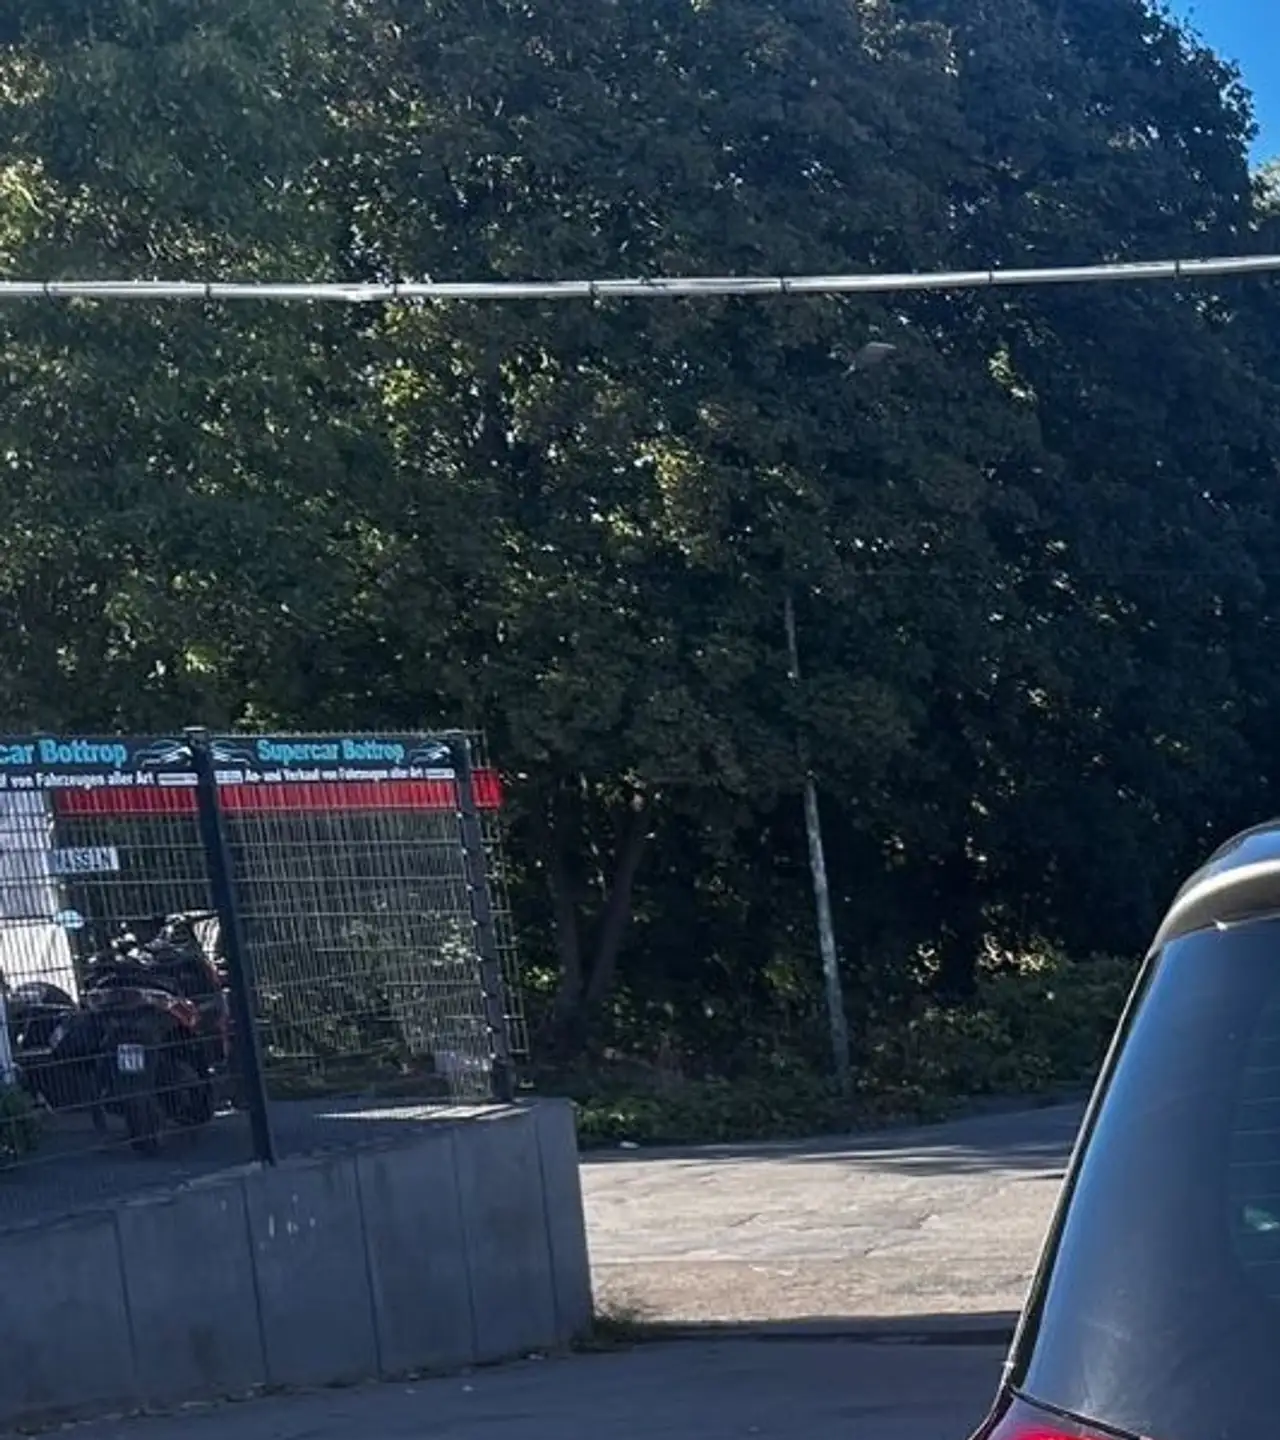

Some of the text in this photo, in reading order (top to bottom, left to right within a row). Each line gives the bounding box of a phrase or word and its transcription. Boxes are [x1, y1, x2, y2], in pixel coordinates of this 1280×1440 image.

[38, 738, 127, 769] Bottrop
[257, 739, 405, 765] Supercar Bottrop
[10, 775, 34, 789] von
[36, 772, 105, 790] Fahrzeugen
[107, 770, 134, 786] aller
[136, 770, 155, 785] Art
